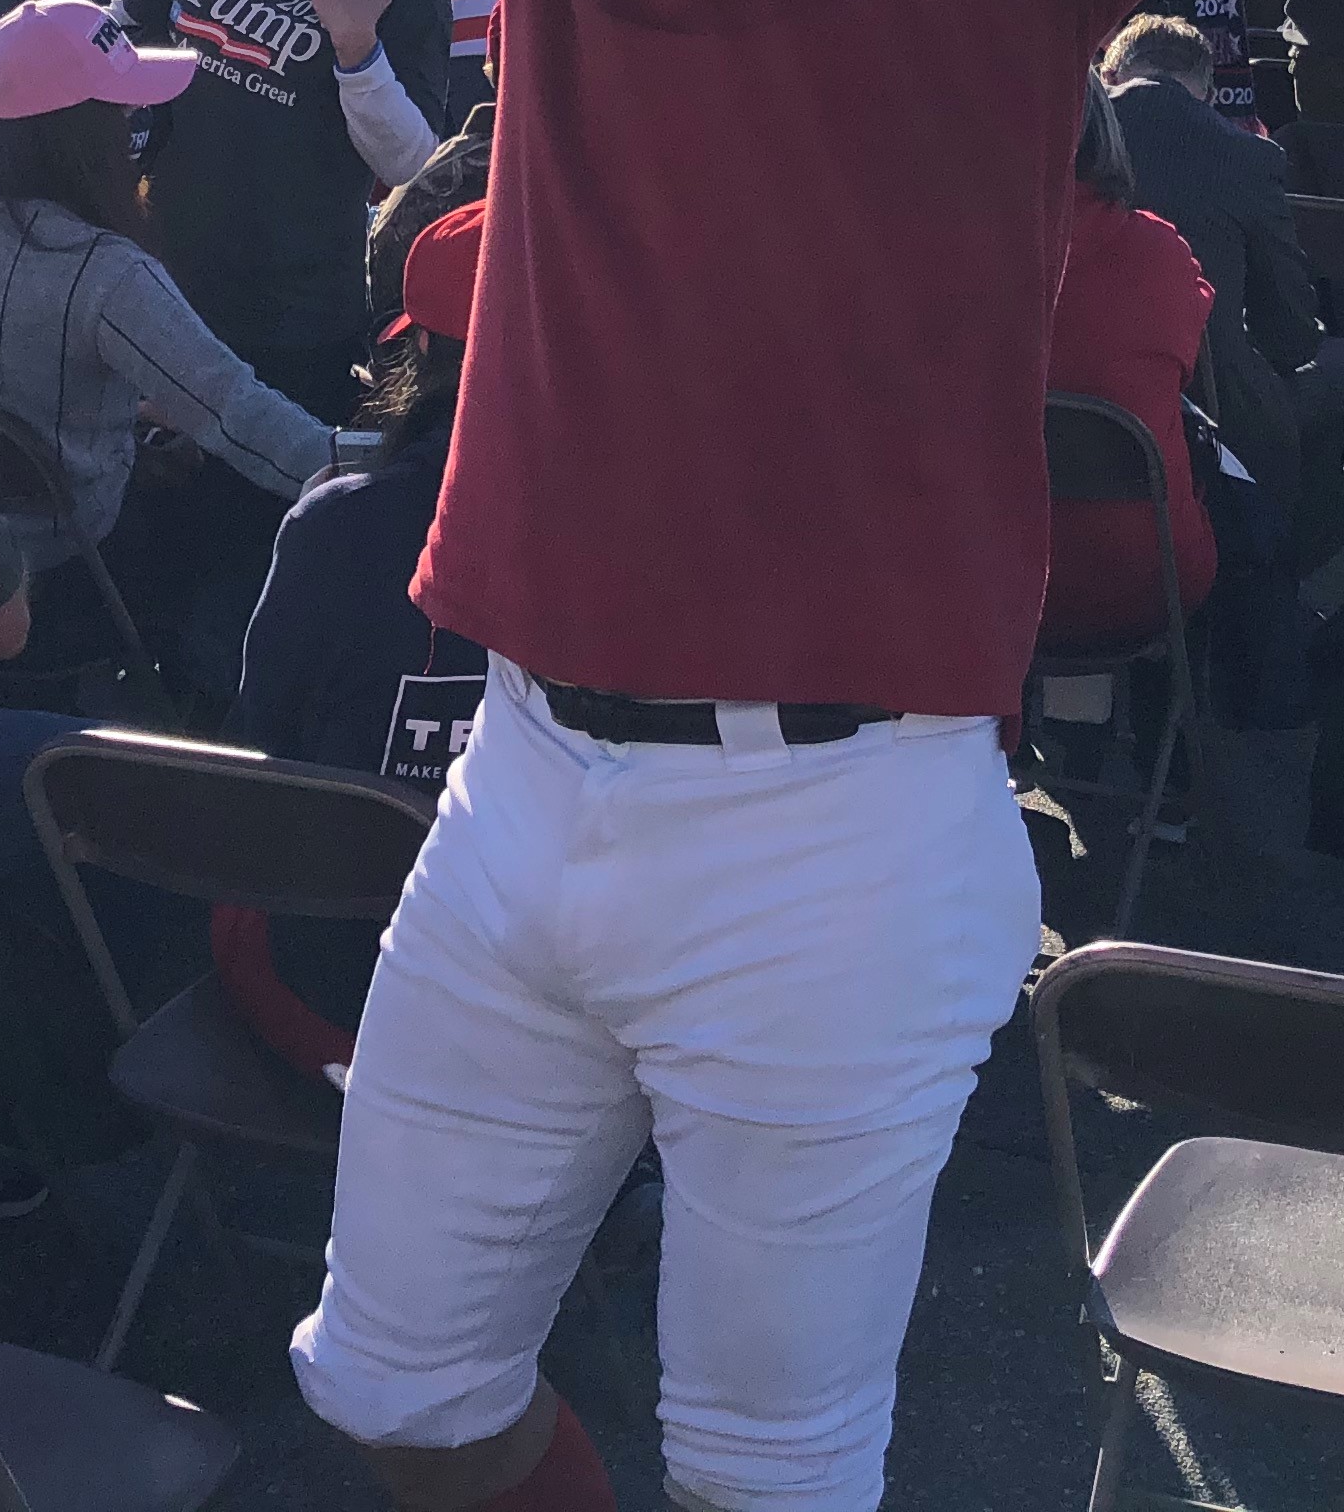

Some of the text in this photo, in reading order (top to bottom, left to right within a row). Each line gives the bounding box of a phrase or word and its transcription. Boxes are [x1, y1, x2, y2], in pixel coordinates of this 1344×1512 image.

[245, 73, 297, 107] Great
[1208, 87, 1253, 105] 2020
[406, 719, 476, 754] TR
[395, 762, 441, 780] MAKE
